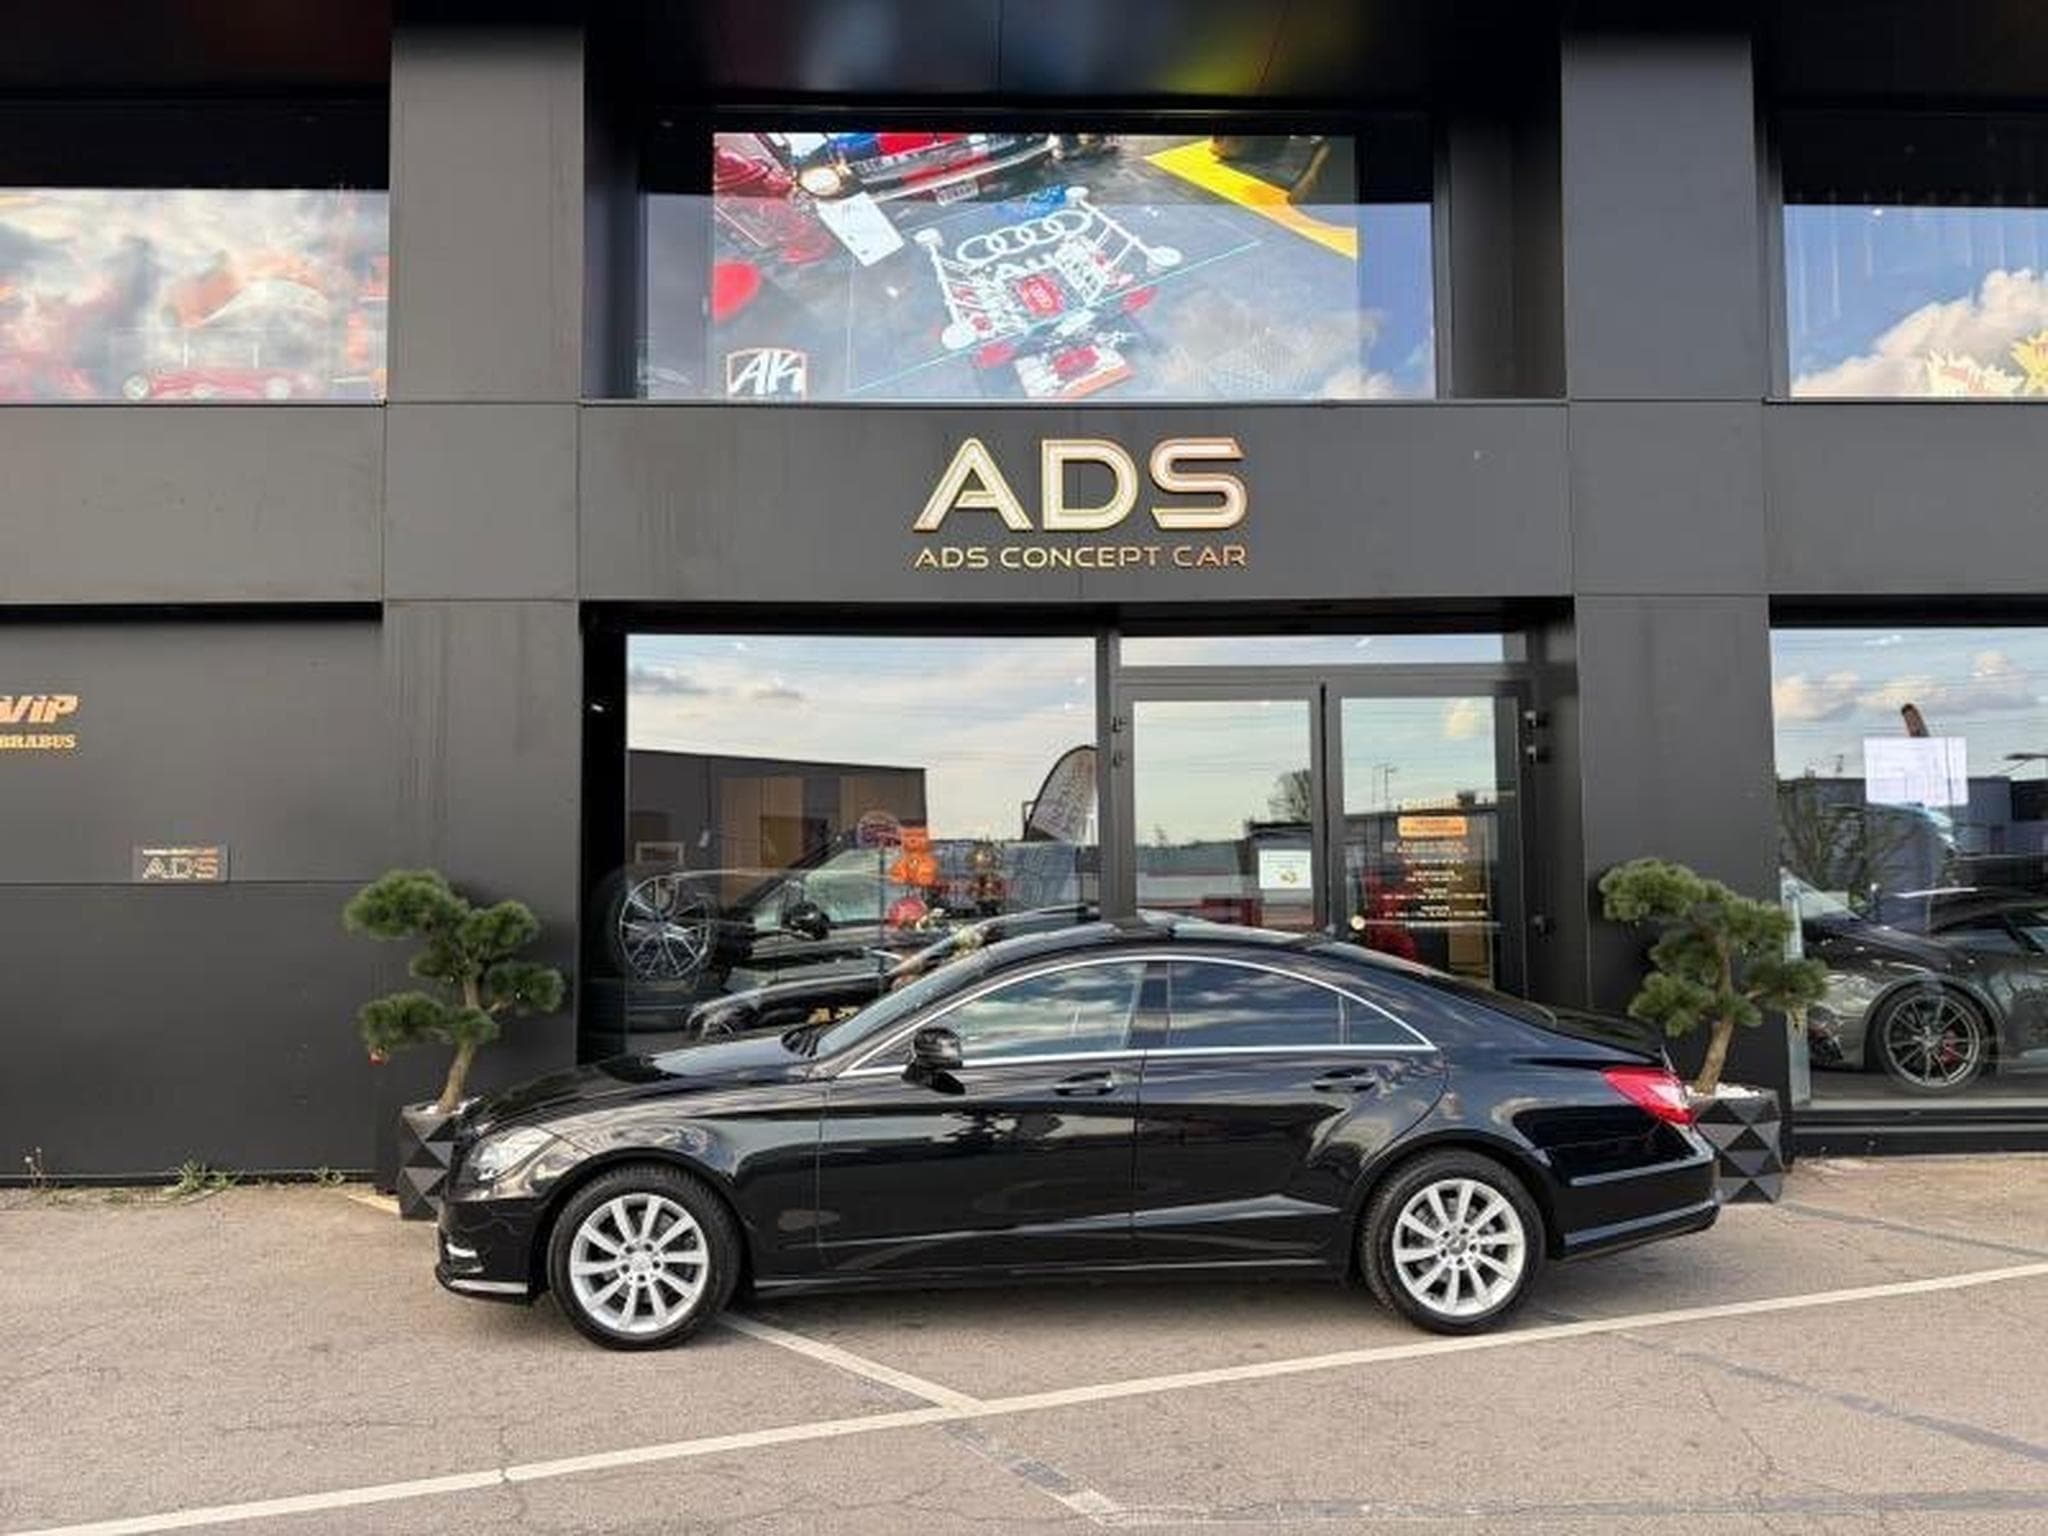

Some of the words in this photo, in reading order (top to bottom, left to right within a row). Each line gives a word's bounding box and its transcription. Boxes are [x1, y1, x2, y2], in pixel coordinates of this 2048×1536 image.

[913, 437, 1247, 530] ADS
[913, 547, 989, 568] ADS
[1000, 546, 1161, 568] CONCEPT
[1173, 546, 1246, 567] CAR
